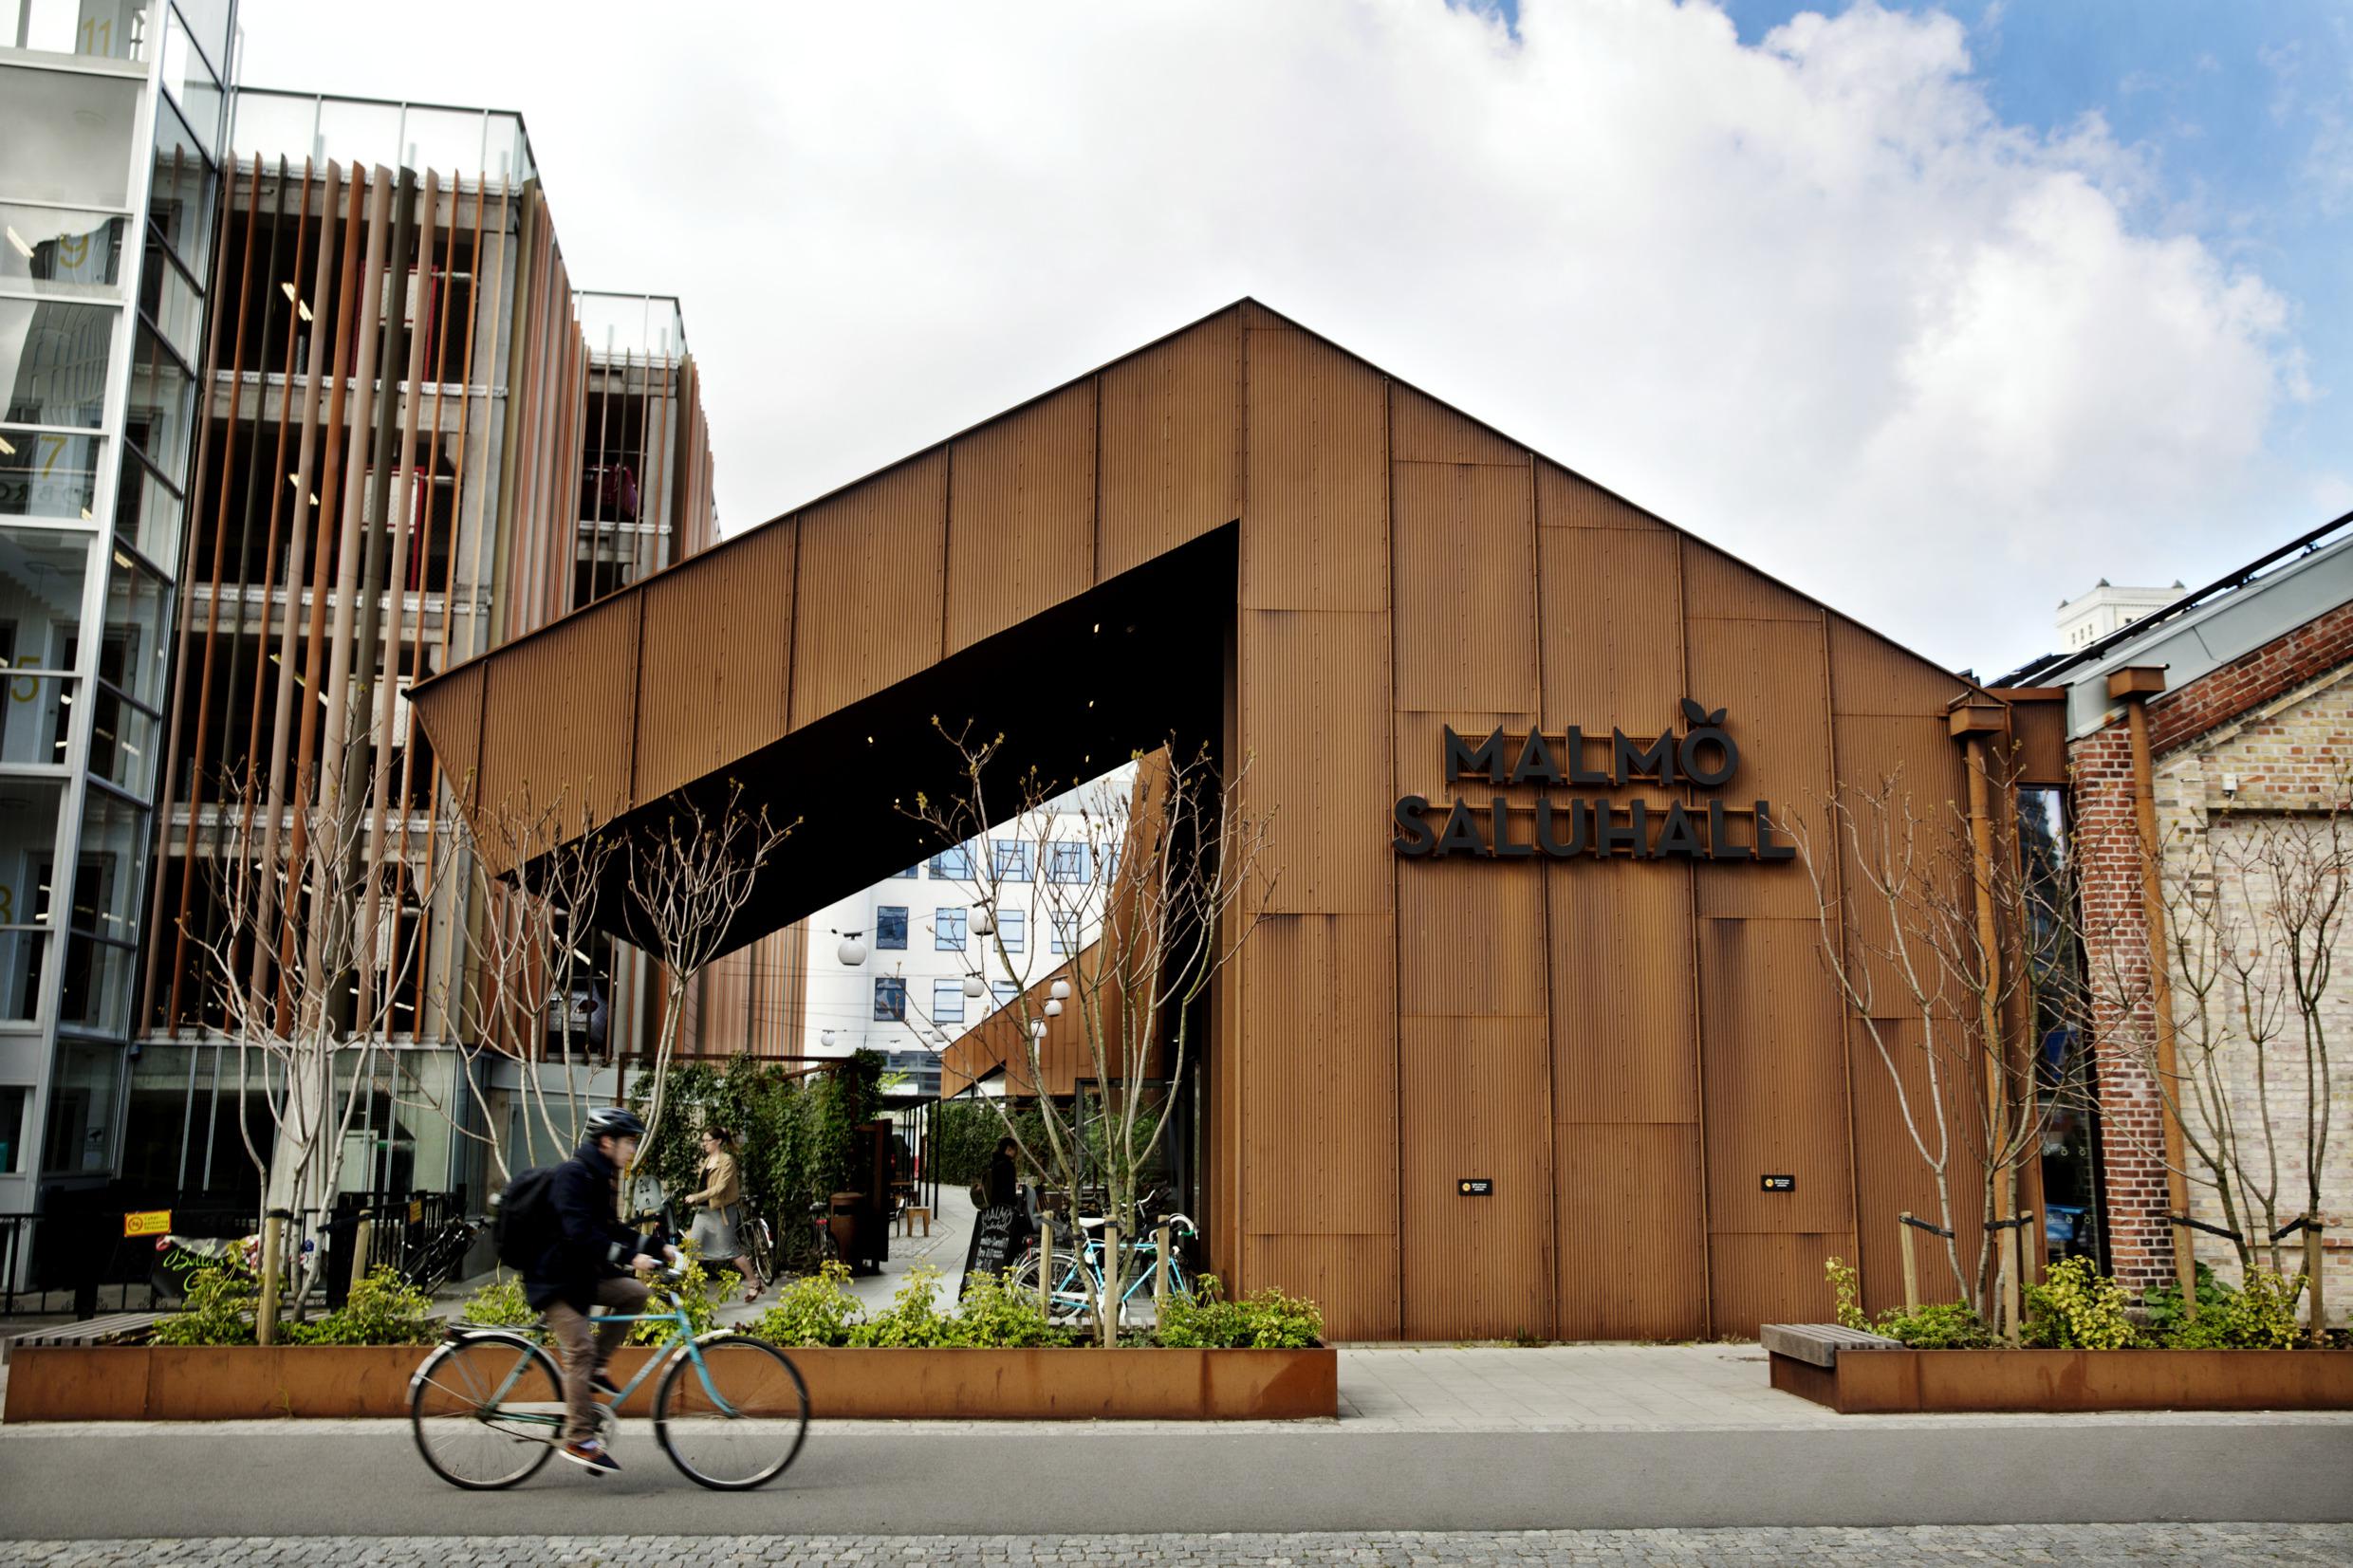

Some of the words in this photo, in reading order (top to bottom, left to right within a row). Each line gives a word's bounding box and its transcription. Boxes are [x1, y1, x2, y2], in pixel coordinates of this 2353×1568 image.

[83, 16, 111, 57] 11
[41, 434, 68, 479] 7
[11, 655, 40, 703] 5
[1444, 698, 1739, 786] MALMÖ
[1393, 795, 1796, 858] SALUHALL
